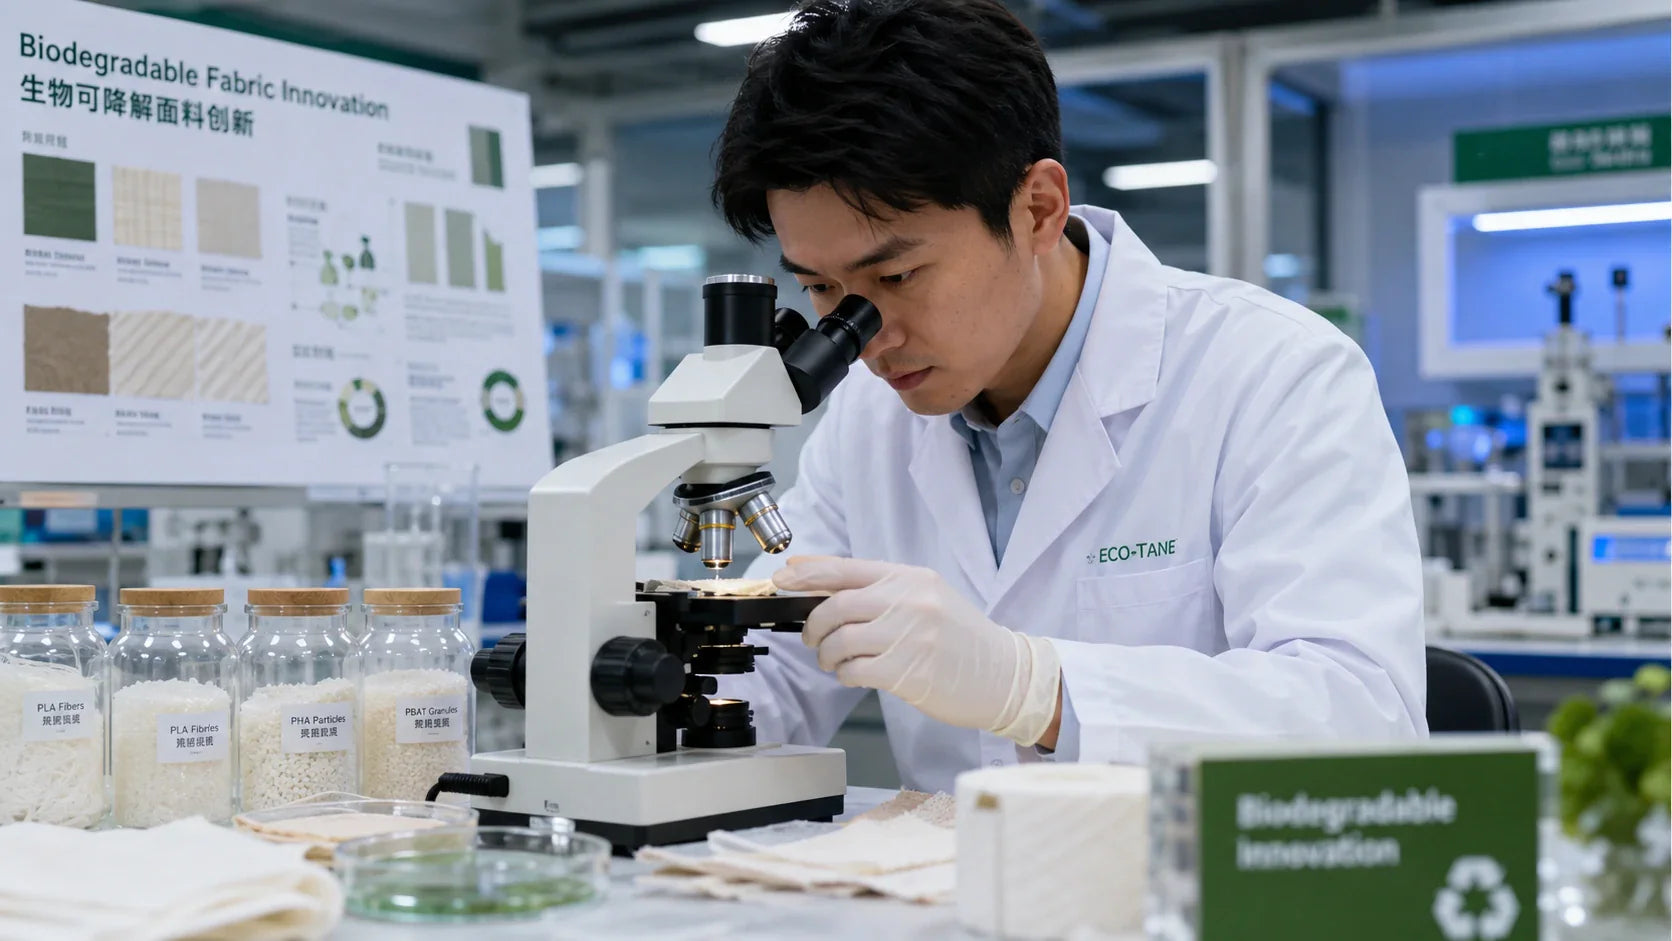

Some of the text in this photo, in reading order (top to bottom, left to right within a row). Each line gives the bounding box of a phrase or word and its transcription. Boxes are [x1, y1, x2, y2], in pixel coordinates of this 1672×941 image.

[19, 32, 390, 120] Biodegradable Fabric Innovation
[20, 73, 255, 138] 生物可降解面料创新
[1099, 539, 1177, 563] ECO-TANE
[37, 702, 85, 713] PLA Fibers
[405, 707, 426, 716] PBAT
[291, 714, 346, 725] PHA Particles
[170, 726, 188, 735] PLA
[1236, 789, 1457, 834] Biodegradable
